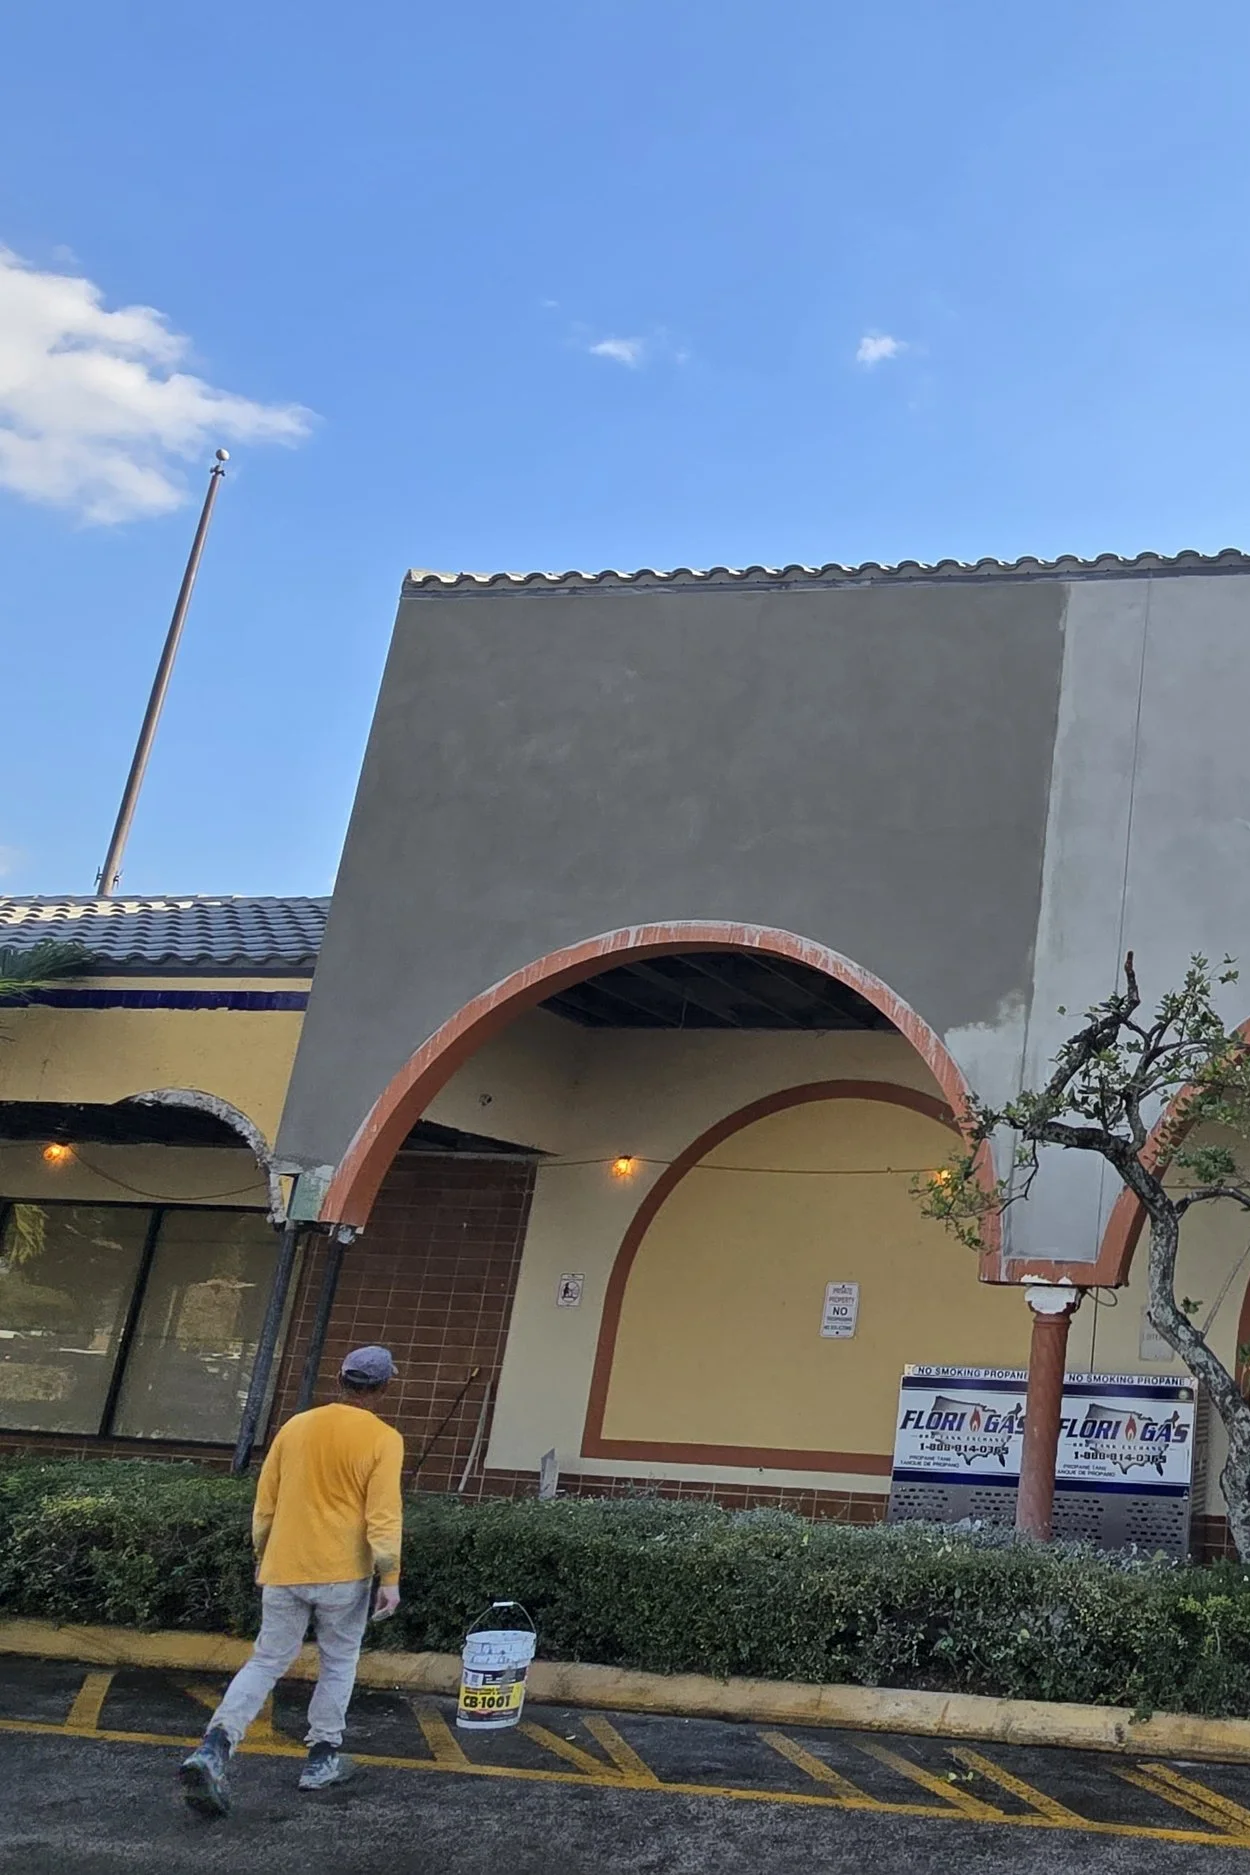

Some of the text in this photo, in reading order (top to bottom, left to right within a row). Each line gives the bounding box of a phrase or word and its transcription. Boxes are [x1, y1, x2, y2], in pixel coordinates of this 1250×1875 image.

[832, 1306, 848, 1316] NO
[918, 1366, 932, 1375] NO
[935, 1367, 981, 1377] SMOKING
[1068, 1373, 1185, 1386] NO SMOKING PROPANE
[900, 1409, 967, 1432] FLORI
[1060, 1418, 1191, 1443] FLORI GAS
[463, 1695, 511, 1709] CB-1001
